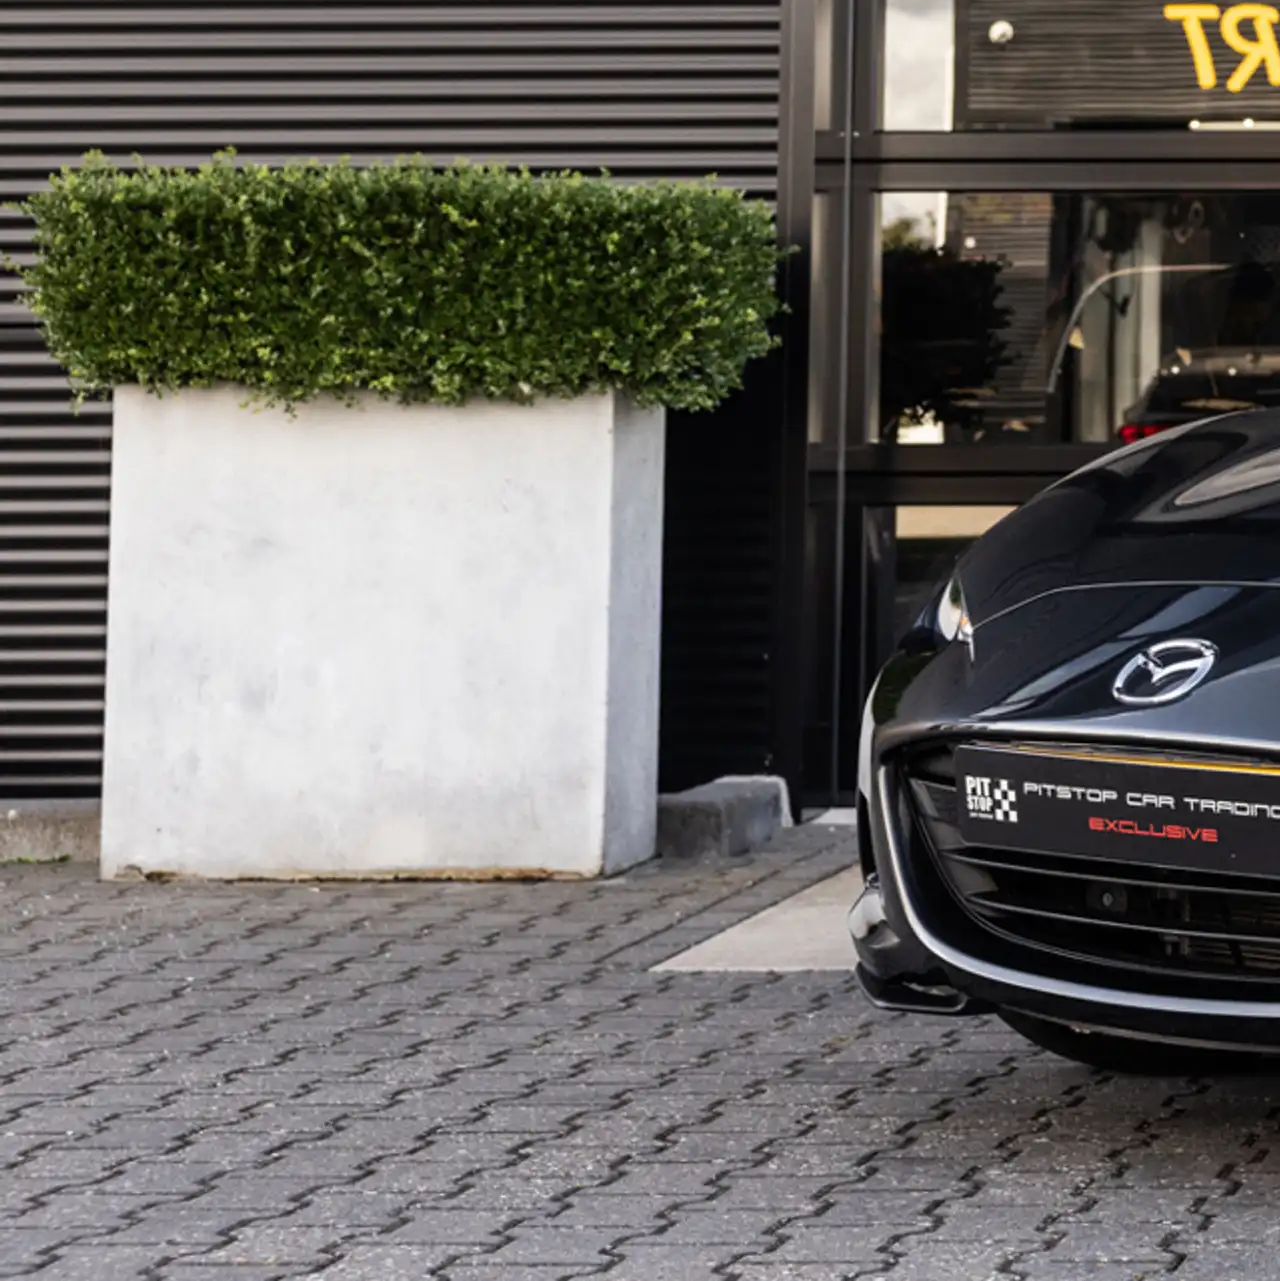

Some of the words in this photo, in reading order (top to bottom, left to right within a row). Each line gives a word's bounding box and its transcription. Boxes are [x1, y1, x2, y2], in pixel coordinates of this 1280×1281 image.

[964, 775, 992, 797] PIT
[1023, 781, 1118, 803] PITSTOP
[1126, 792, 1175, 810] CAR
[966, 795, 994, 812] STOP
[1088, 816, 1218, 843] EXCLUSIVE
